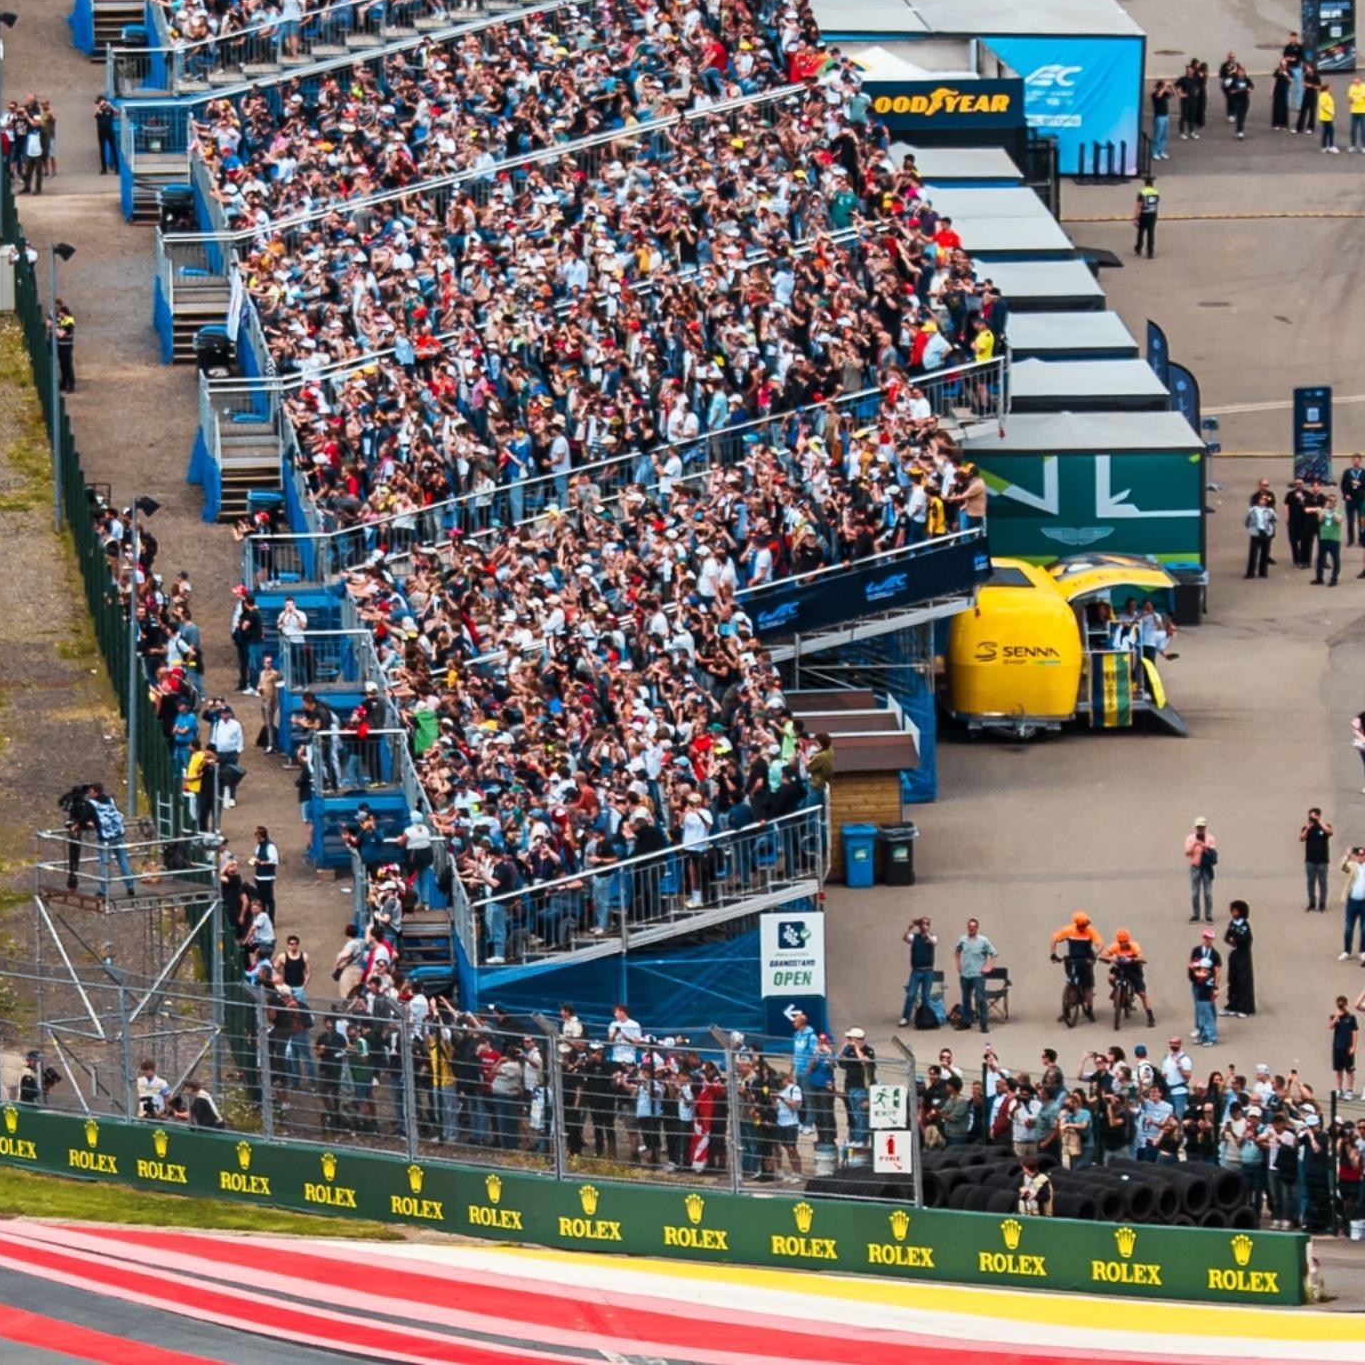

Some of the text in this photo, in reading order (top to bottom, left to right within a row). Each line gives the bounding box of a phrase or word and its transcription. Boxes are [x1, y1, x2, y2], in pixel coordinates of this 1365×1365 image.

[1025, 64, 1083, 86] EC
[874, 87, 1010, 116] OODYEAR
[1003, 646, 1060, 658] SENNA
[773, 970, 813, 986] OPEN
[69, 1148, 118, 1174] ROLEX
[137, 1159, 188, 1184] ROLEX
[220, 1172, 271, 1195] ROLEX
[304, 1183, 357, 1209] ROLEX
[391, 1195, 444, 1221] ROLEX
[469, 1205, 523, 1231] ROLEX
[558, 1216, 623, 1242] ROLEX
[663, 1225, 729, 1251] ROLEX
[771, 1235, 838, 1259] ROLEX
[868, 1243, 936, 1269] ROLEX
[979, 1252, 1047, 1276] ROLEX
[1092, 1260, 1162, 1285] ROLEX
[1208, 1269, 1280, 1293] ROLEX
